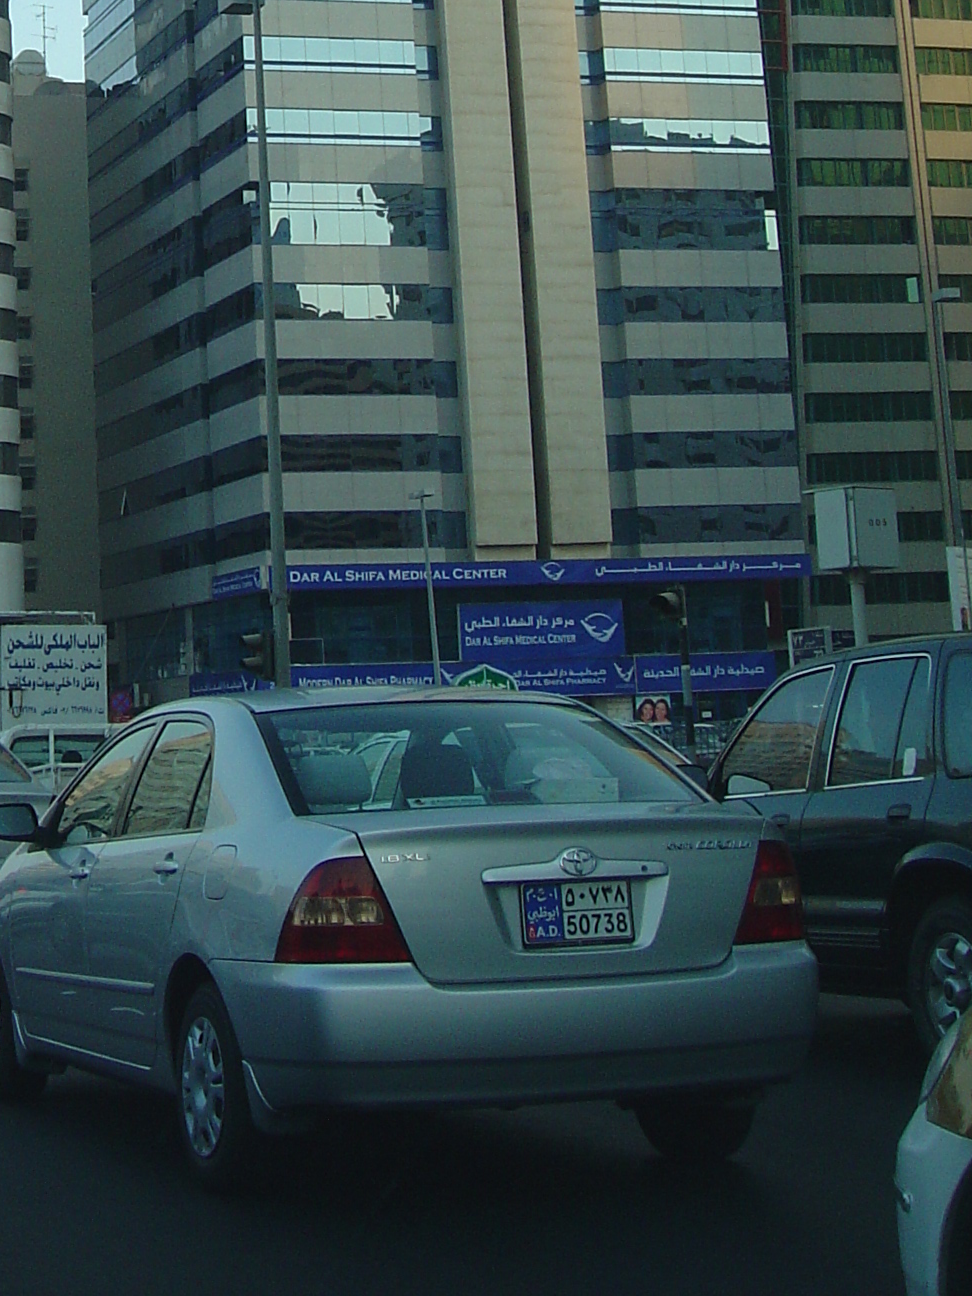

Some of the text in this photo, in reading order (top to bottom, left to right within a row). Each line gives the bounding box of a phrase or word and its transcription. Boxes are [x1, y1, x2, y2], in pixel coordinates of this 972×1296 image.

[289, 567, 507, 583] DAR AL SHIFA MEDICAL CENTER
[595, 560, 802, 577] مركز دار الشفاء الطبي
[464, 615, 575, 633] مركز دار الشفاء الطبي
[7, 630, 44, 655] للشحن
[76, 632, 104, 654] الباب
[465, 633, 577, 647] DAR AL SHIFA MEDICAL CENTER
[9, 657, 103, 673] شحن تخليص تغليف
[712, 665, 726, 679] دار
[728, 663, 765, 677] صيدلية
[334, 676, 352, 687] DAR
[354, 676, 364, 686] AL
[390, 675, 434, 686] PHARMACY
[559, 668, 568, 679] دار
[81, 676, 100, 692] ونقل
[566, 677, 607, 687] PHARMACY
[565, 885, 625, 907] ٥٠٧٣٨
[536, 925, 562, 938] A.D.
[566, 912, 628, 936] 50738
